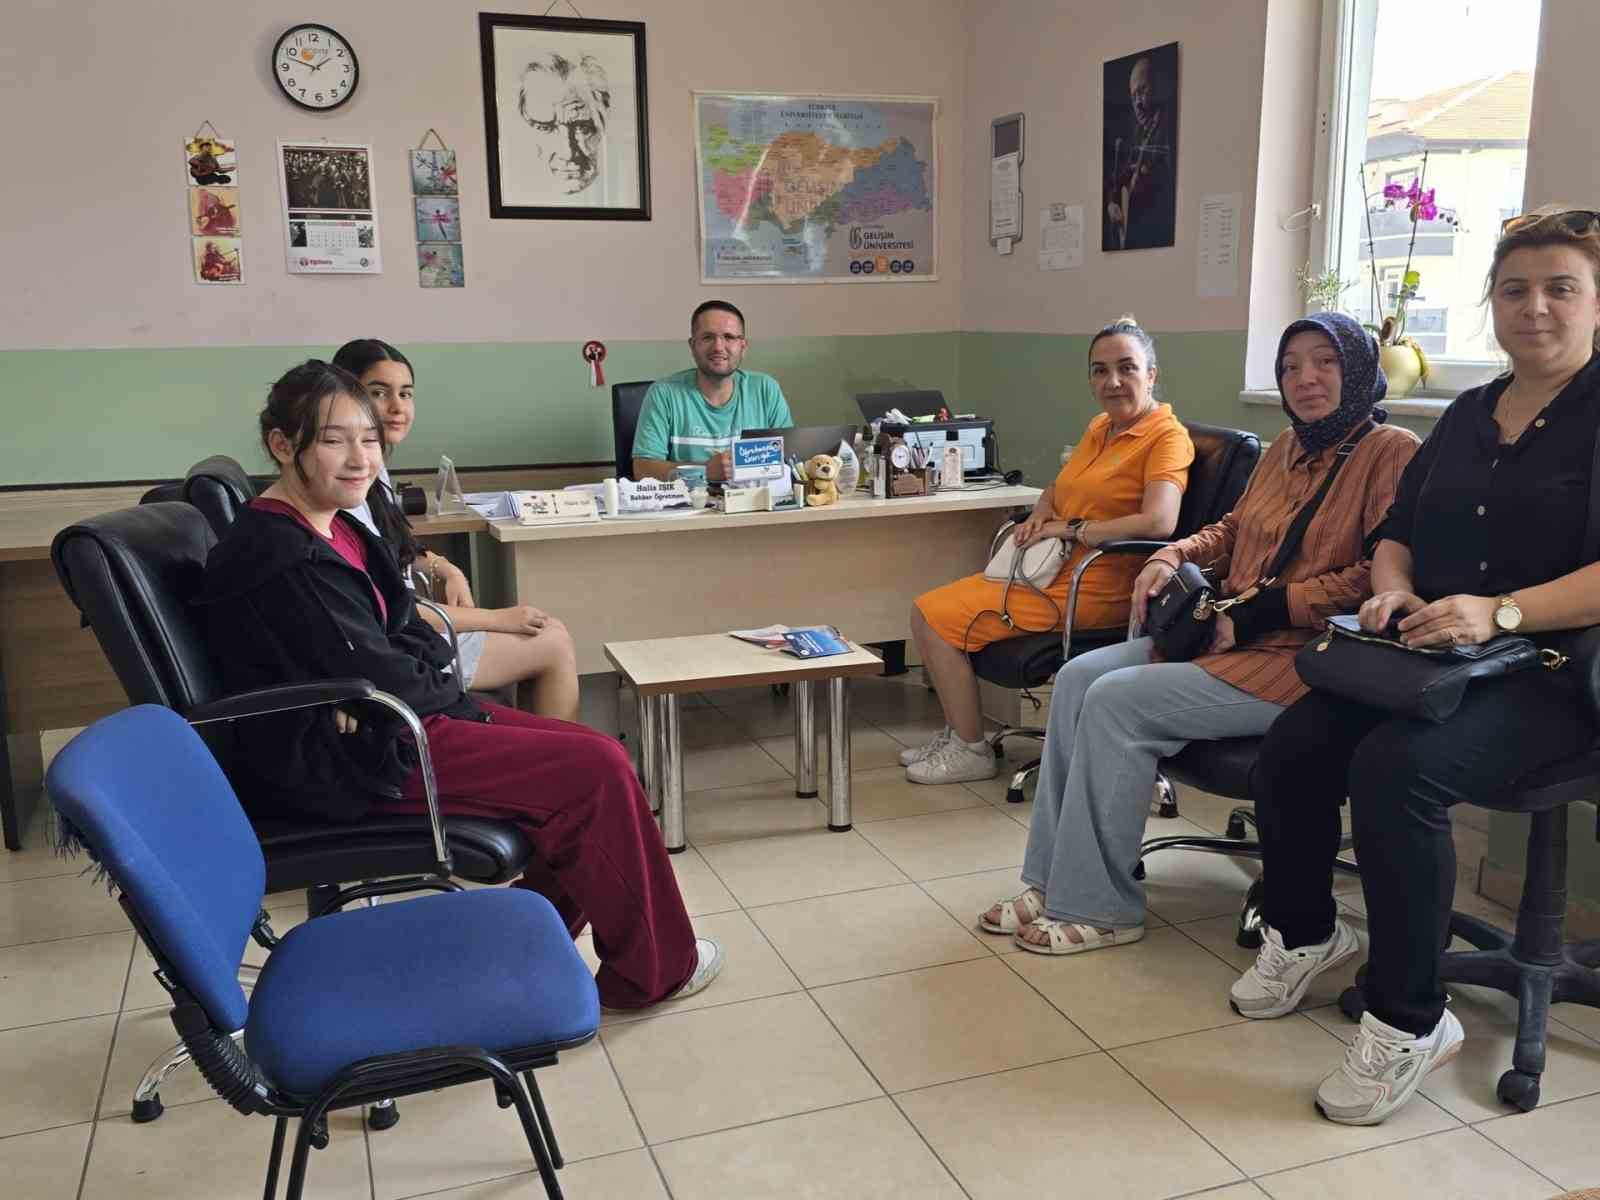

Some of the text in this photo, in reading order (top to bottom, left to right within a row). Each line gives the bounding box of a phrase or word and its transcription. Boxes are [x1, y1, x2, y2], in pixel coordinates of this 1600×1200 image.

[295, 37, 302, 47] 11
[308, 33, 320, 42] 12
[286, 47, 298, 57] 10
[336, 48, 345, 58] 2
[281, 63, 290, 72] 9
[343, 64, 350, 73] 3
[287, 78, 296, 87] 8
[340, 80, 347, 88] 4
[298, 88, 306, 98] 7
[315, 93, 324, 102] 6
[330, 88, 338, 98] 5
